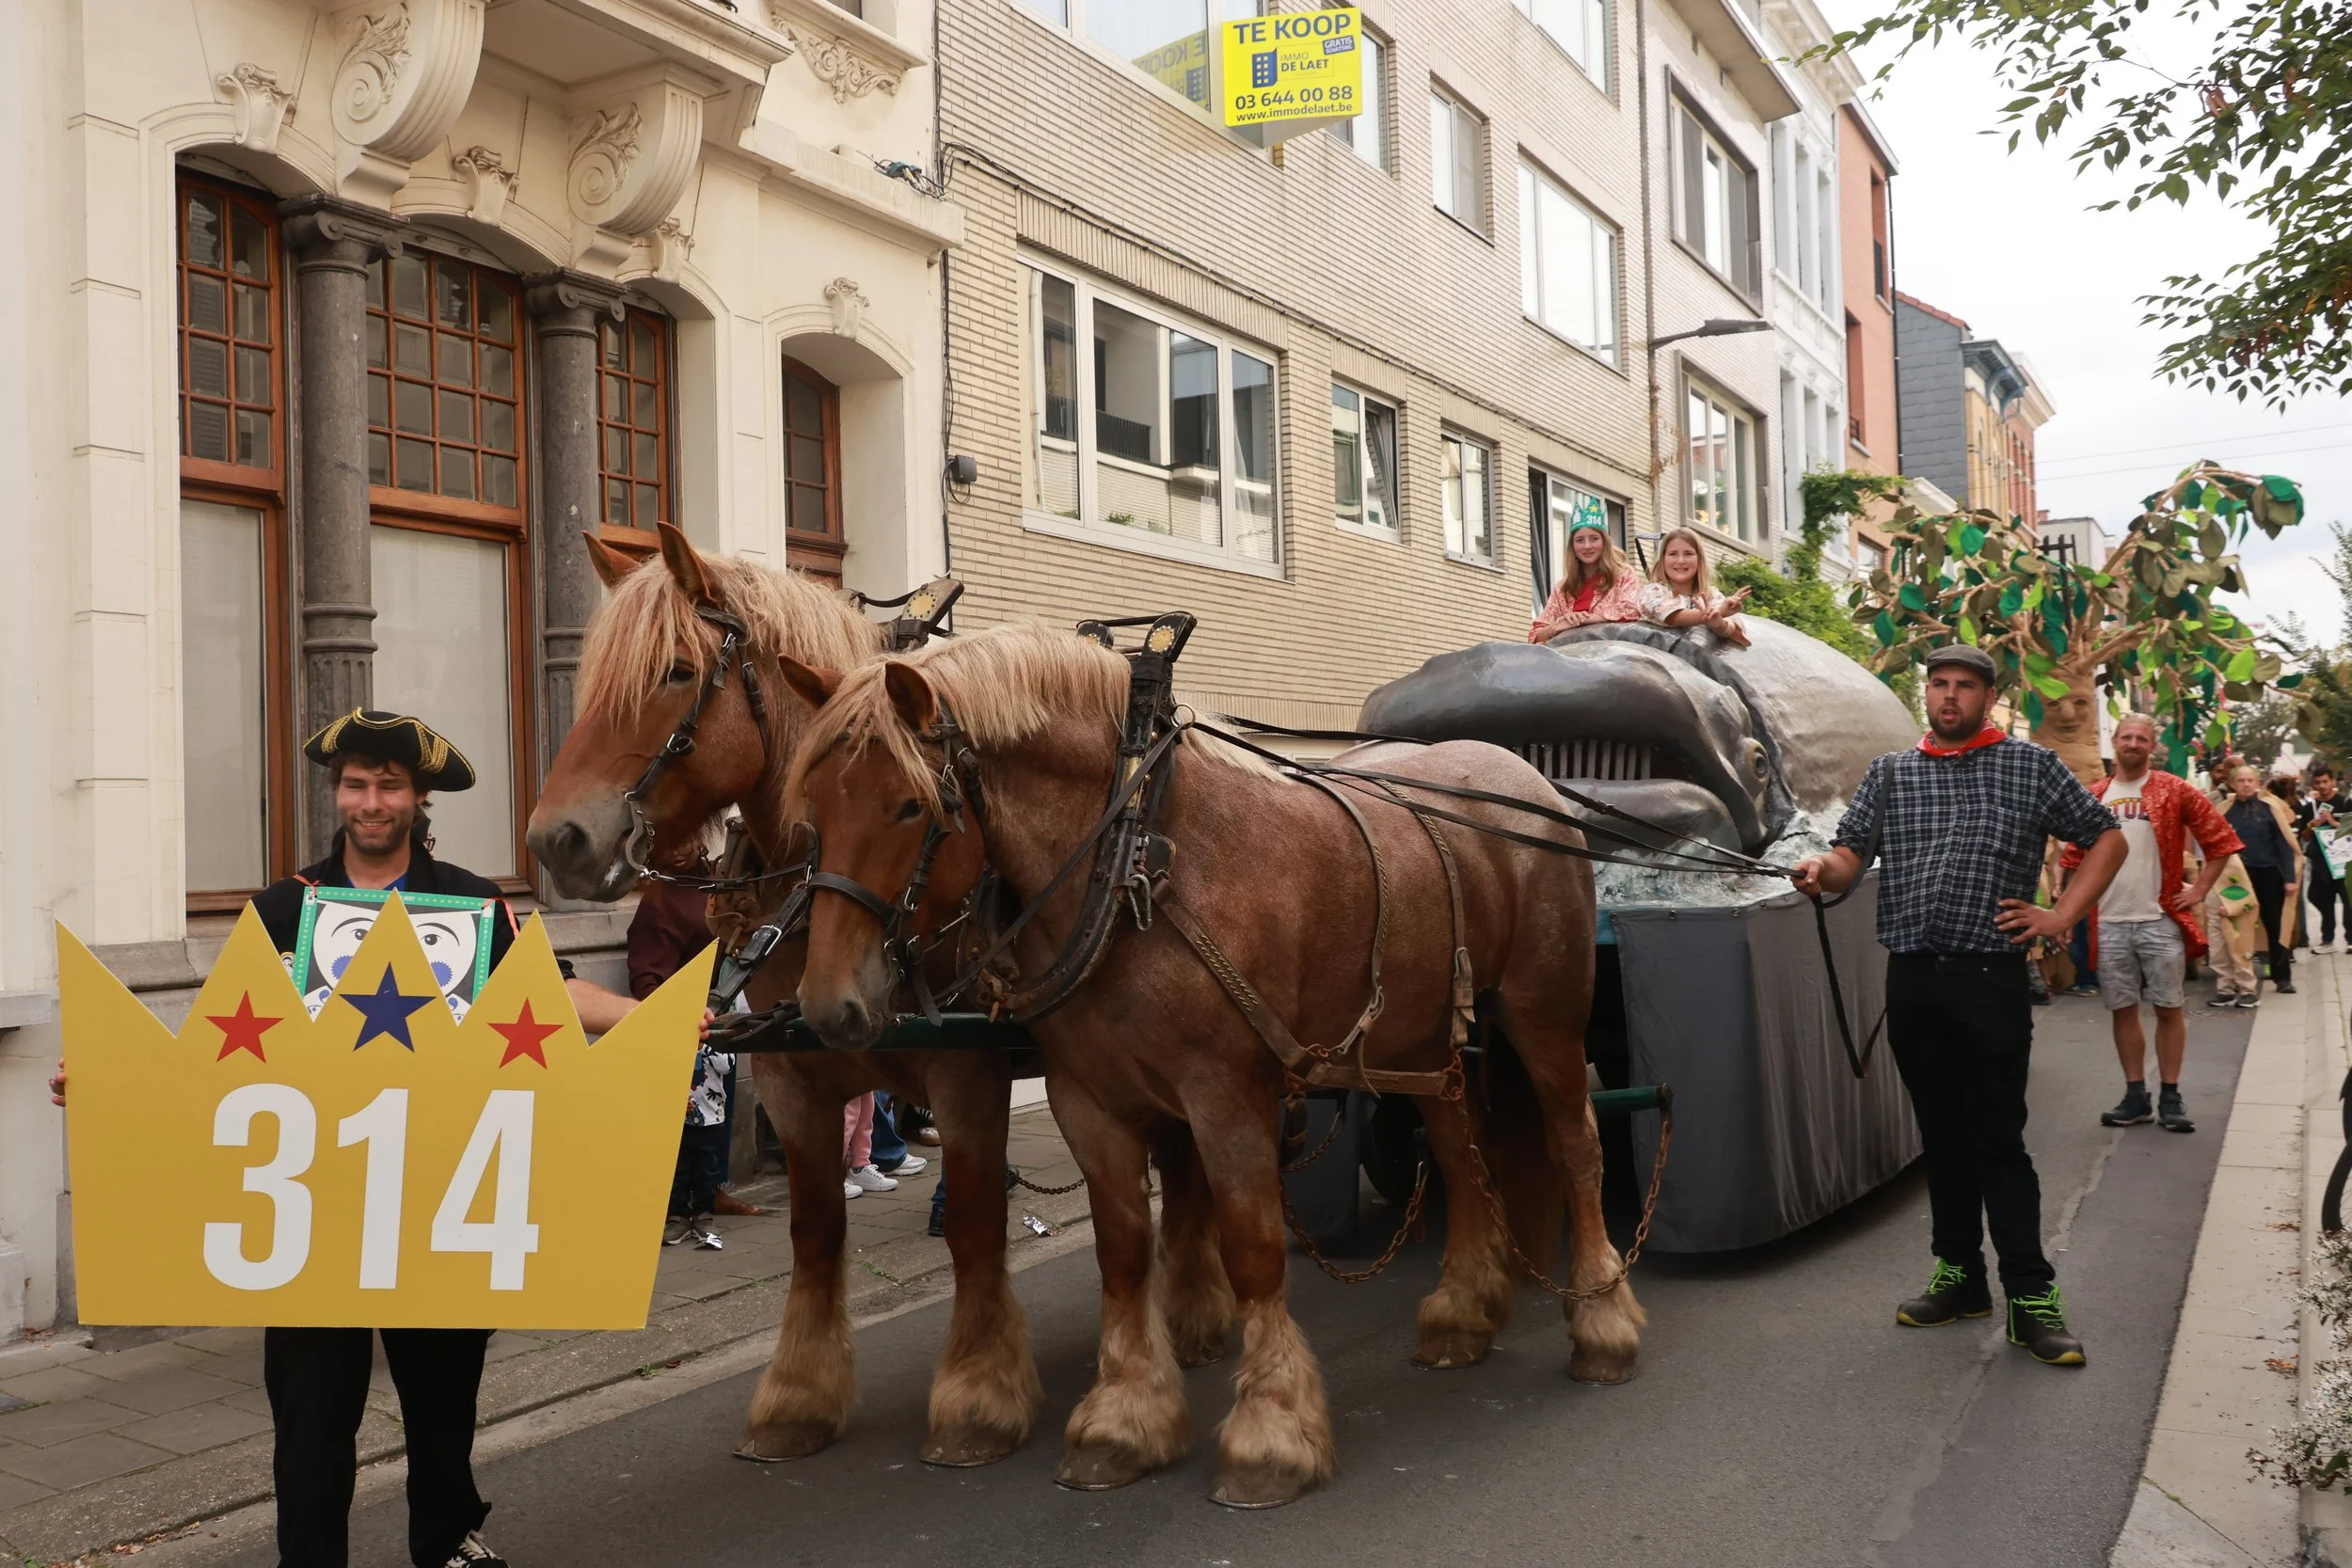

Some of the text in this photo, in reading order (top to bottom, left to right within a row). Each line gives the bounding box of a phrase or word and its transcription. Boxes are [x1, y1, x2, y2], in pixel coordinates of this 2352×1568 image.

[1232, 13, 1351, 44] TE KOOP
[1324, 36, 1353, 48] GRATIS
[1279, 52, 1309, 62] IMMO
[1280, 58, 1329, 72] DE LAET
[1235, 85, 1353, 110] 03 644 00 88
[1235, 102, 1353, 122] www.immodelaet.be
[1586, 515, 1602, 526] 314
[202, 1083, 539, 1291] 314
